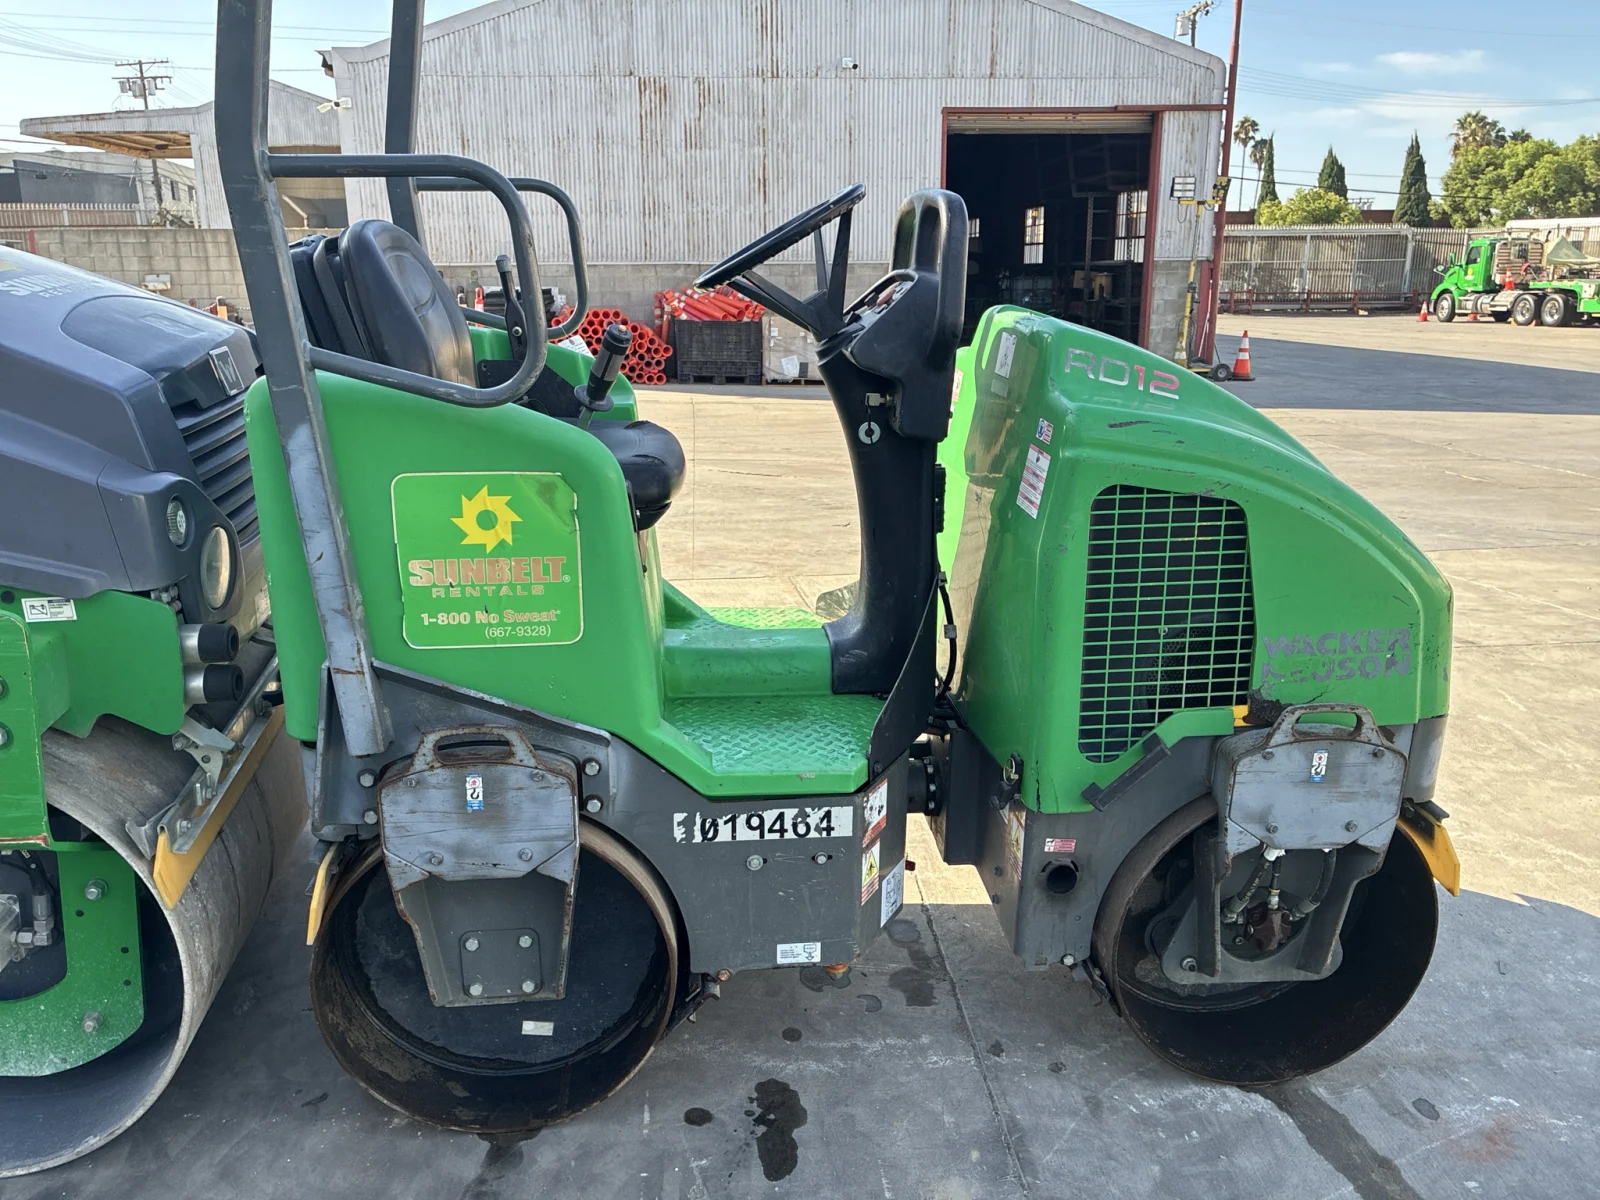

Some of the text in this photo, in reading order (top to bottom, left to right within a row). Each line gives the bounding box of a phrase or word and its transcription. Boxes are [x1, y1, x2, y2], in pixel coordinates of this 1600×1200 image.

[1064, 347, 1180, 400] RD12
[431, 585, 545, 598] RENTALS
[420, 612, 471, 626] 1-800
[475, 610, 499, 624] No
[484, 624, 552, 640] (667-9328)
[1261, 628, 1411, 660] WACKER
